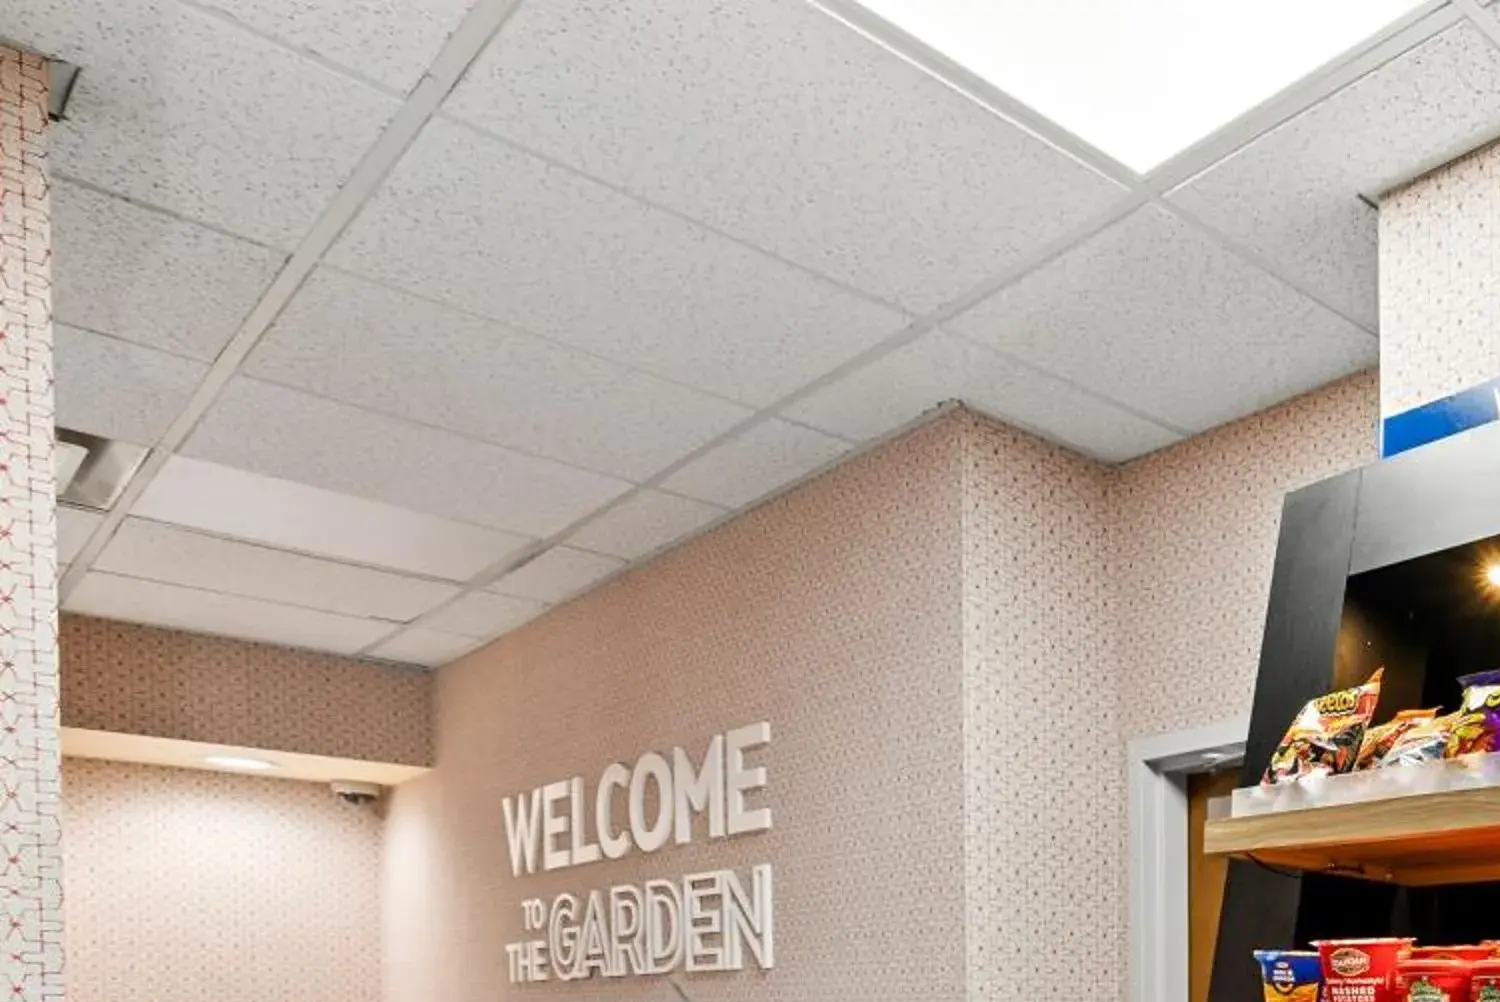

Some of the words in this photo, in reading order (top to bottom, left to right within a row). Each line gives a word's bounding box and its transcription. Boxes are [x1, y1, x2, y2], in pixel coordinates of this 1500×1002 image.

[502, 721, 773, 877] WELCOME
[506, 940, 548, 982] THE
[549, 864, 774, 981] GARDEN
[522, 899, 543, 930] TO
